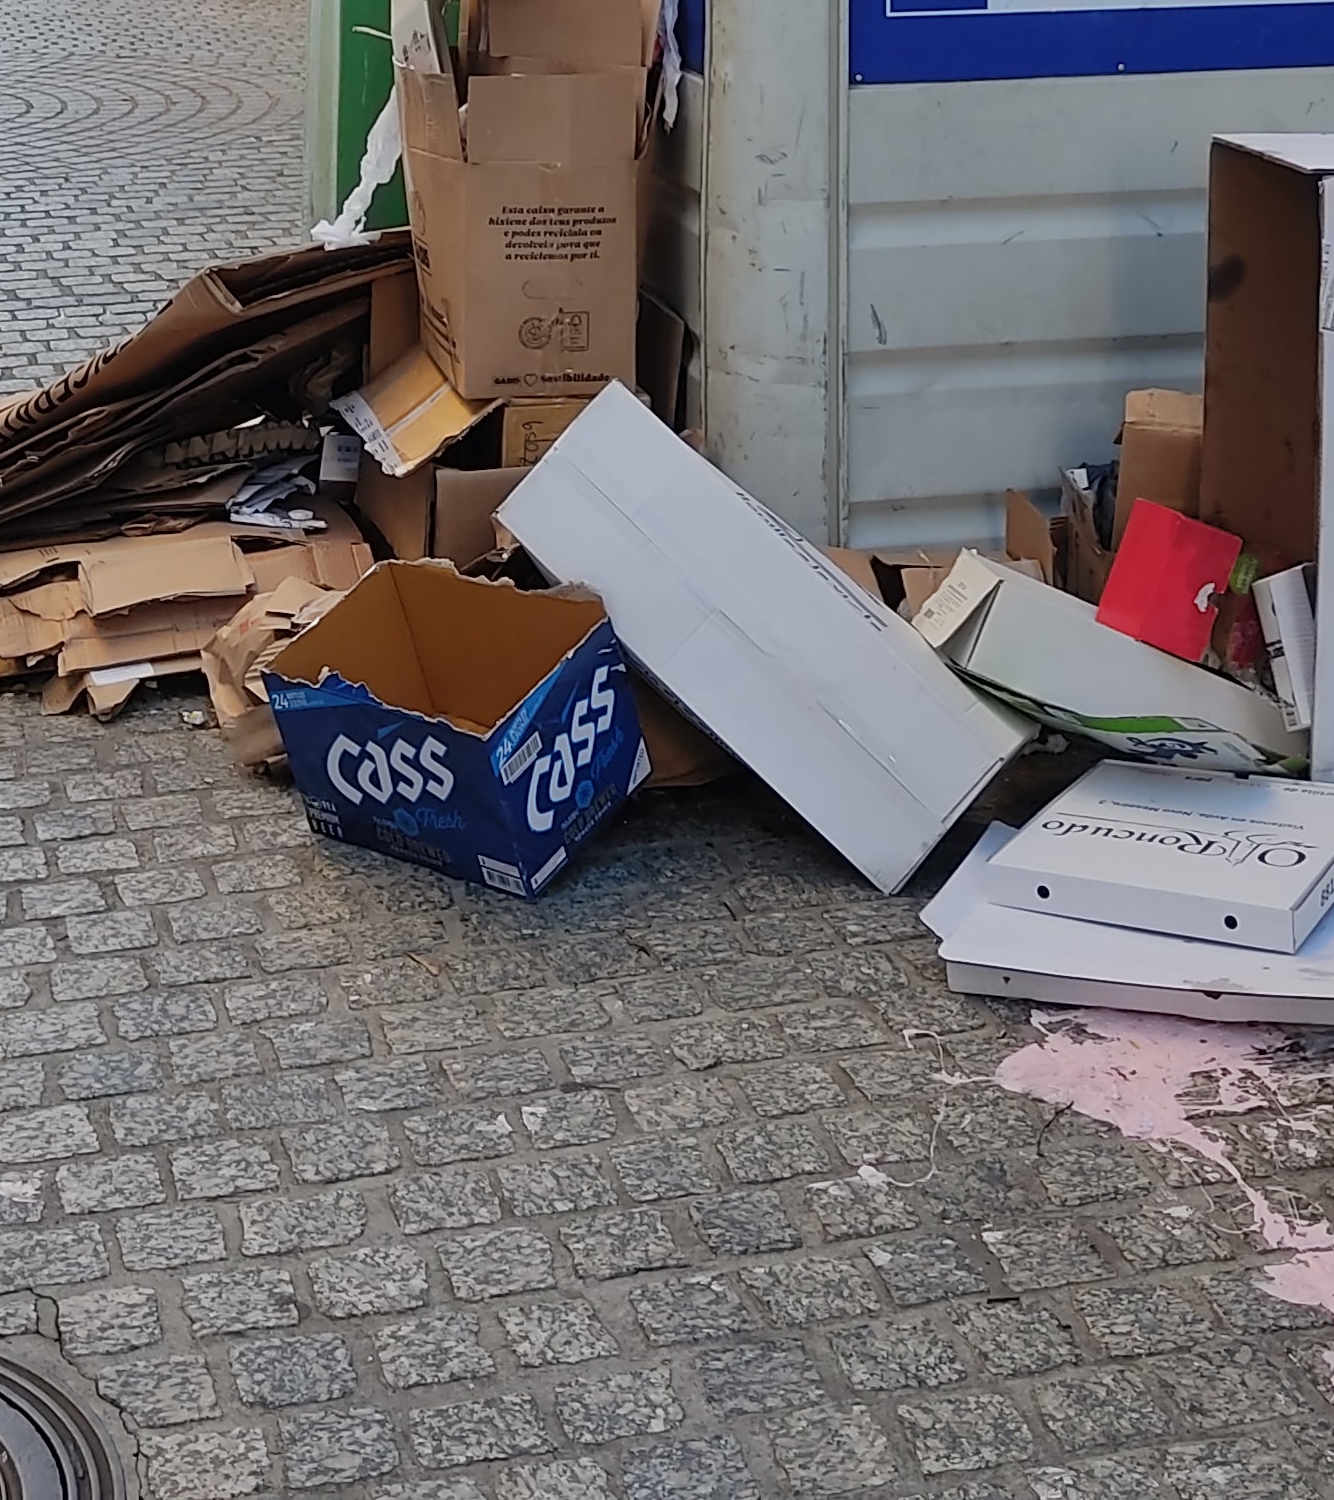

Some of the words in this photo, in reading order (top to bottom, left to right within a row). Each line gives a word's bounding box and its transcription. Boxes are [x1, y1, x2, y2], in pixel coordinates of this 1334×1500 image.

[501, 205, 525, 215] Esta
[556, 205, 596, 217] garante
[582, 239, 601, 250] que
[271, 692, 290, 710] 24
[495, 735, 514, 764] 24
[1282, 786, 1300, 795] de
[1042, 819, 1227, 857] Roncudo
